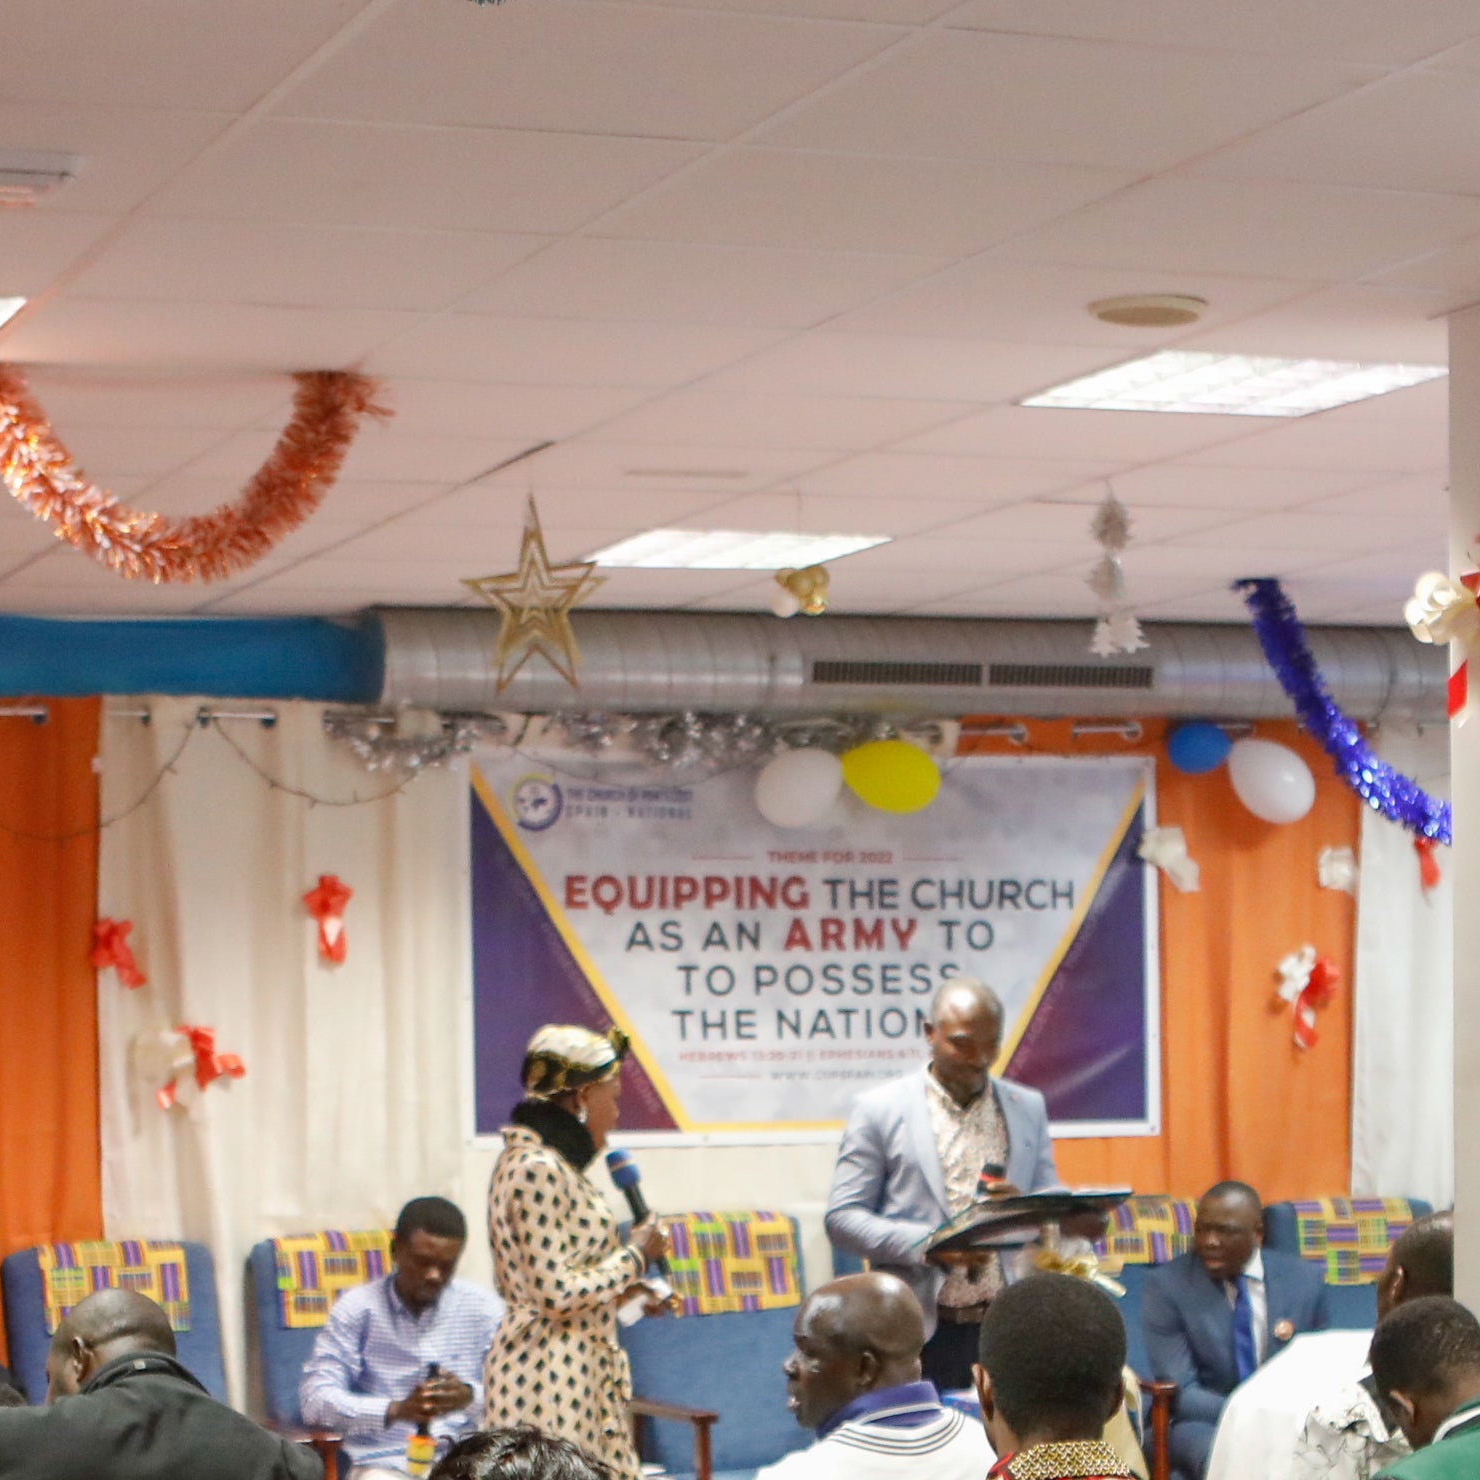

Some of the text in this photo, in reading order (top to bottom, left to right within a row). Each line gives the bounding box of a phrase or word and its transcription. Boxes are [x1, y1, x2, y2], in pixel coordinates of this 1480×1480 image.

[767, 851, 818, 863] THEME
[822, 851, 855, 864] FOR
[564, 874, 1075, 915] EQUIPPING THE CHURCH
[626, 917, 995, 952] AS AN ARMY TO
[677, 964, 736, 996] TO
[671, 1009, 757, 1040] THE
